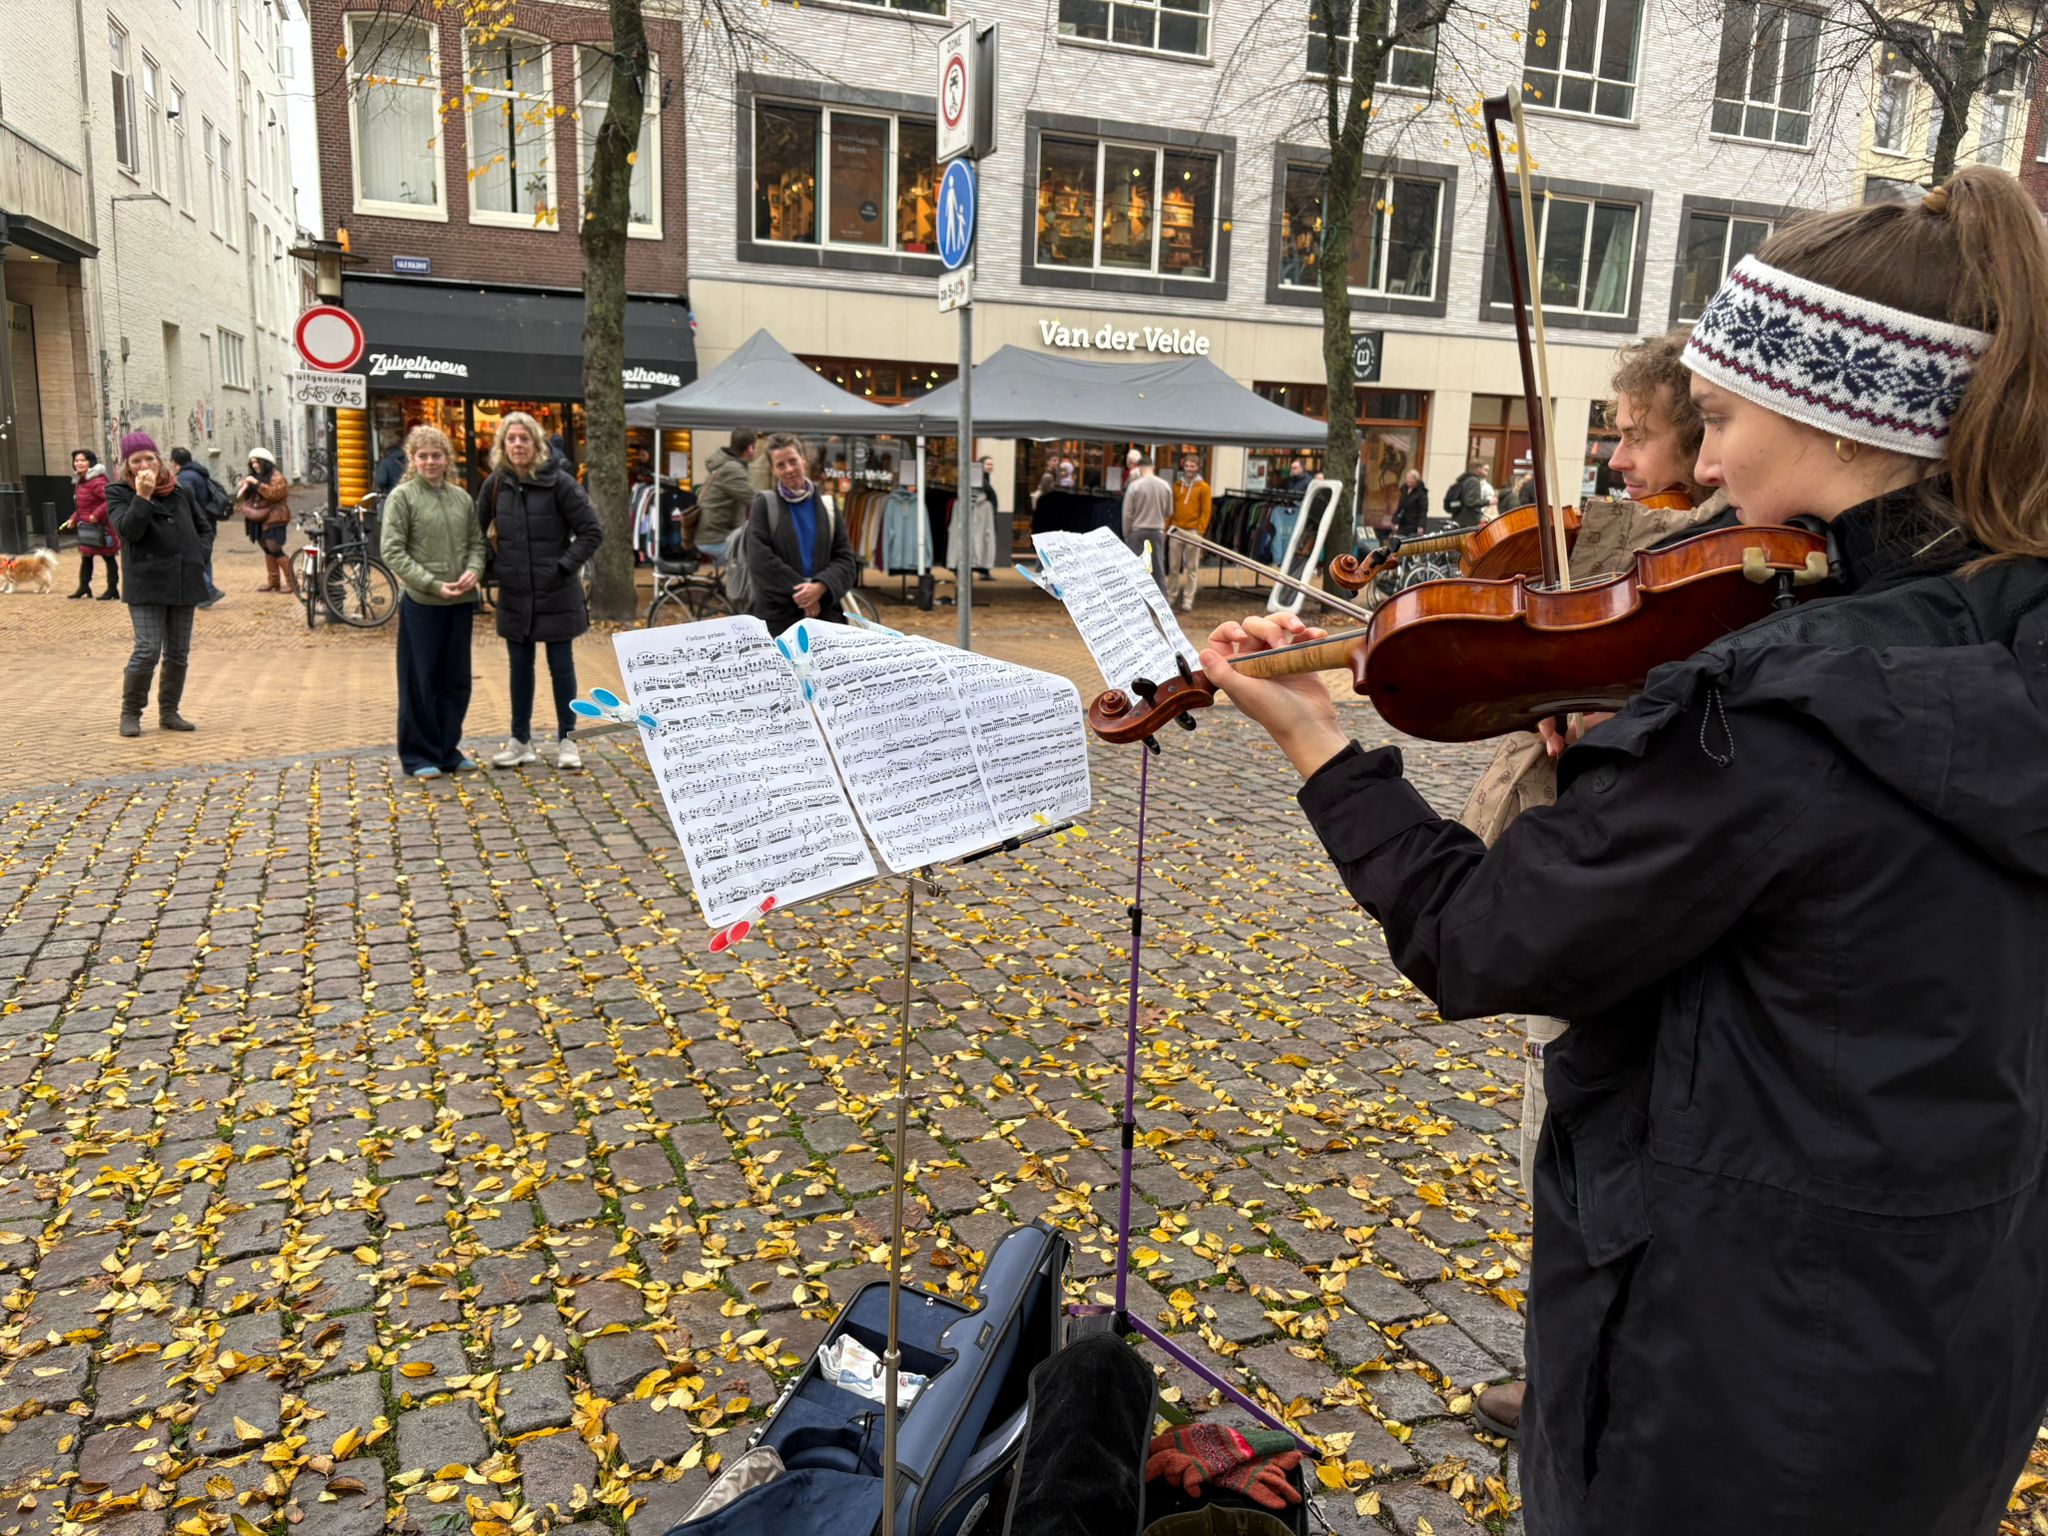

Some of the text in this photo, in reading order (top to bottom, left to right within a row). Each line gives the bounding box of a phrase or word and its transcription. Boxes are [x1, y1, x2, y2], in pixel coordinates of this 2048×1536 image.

[947, 33, 961, 52] ZONE
[1039, 319, 1210, 355] Van der Velde
[369, 354, 469, 377] Zuivelhoeve
[296, 374, 362, 385] uitgezonderd
